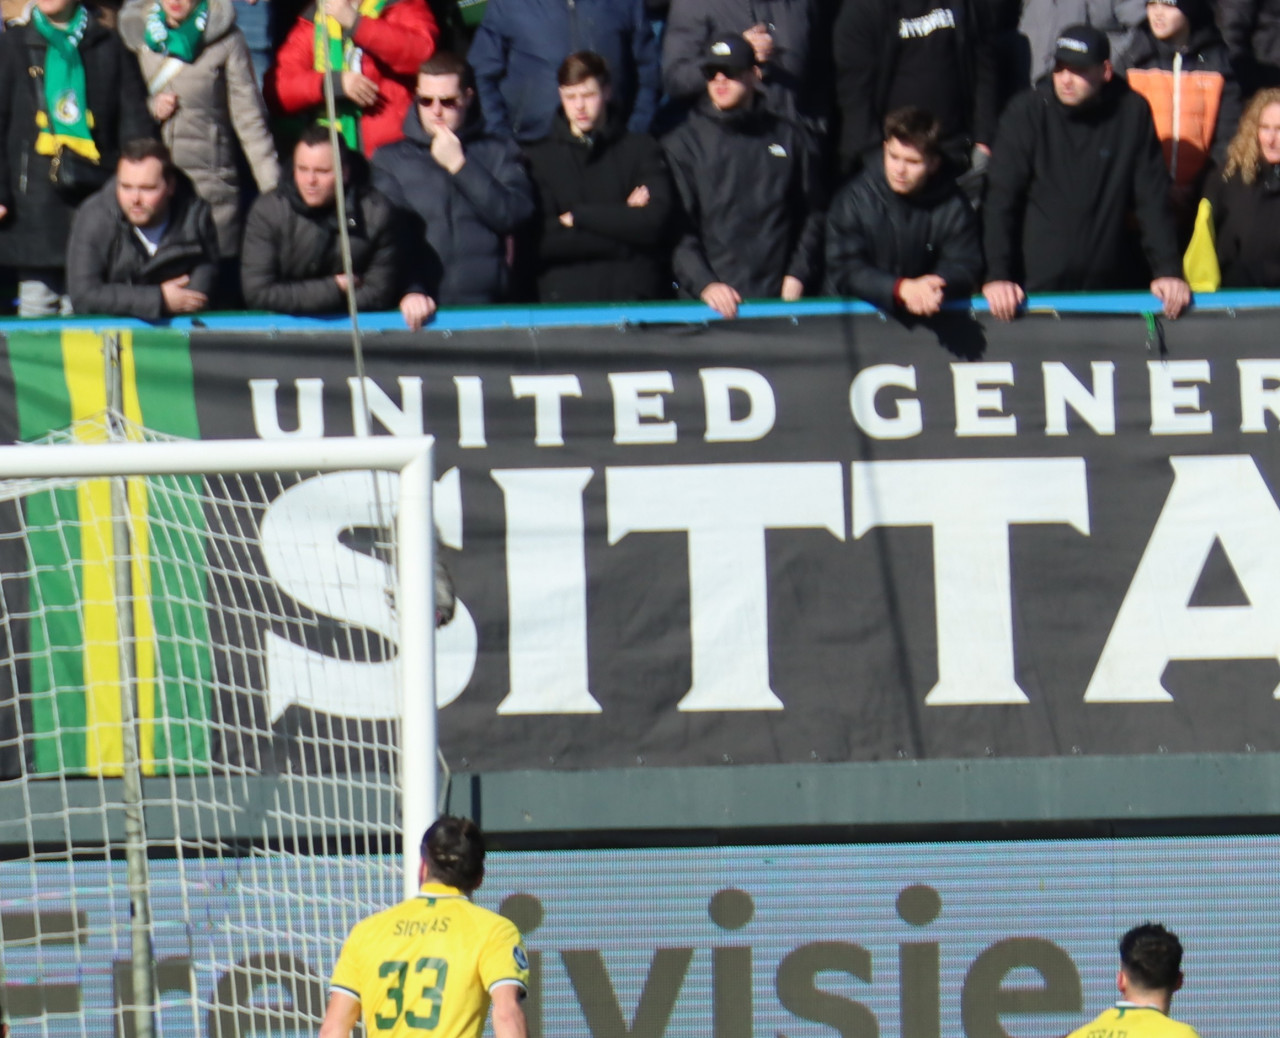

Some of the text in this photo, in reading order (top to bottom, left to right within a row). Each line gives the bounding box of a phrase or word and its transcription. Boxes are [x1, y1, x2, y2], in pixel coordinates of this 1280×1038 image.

[249, 359, 1280, 446] UNITED GENER
[260, 456, 1280, 724] SITTA
[374, 957, 449, 1030] 33
